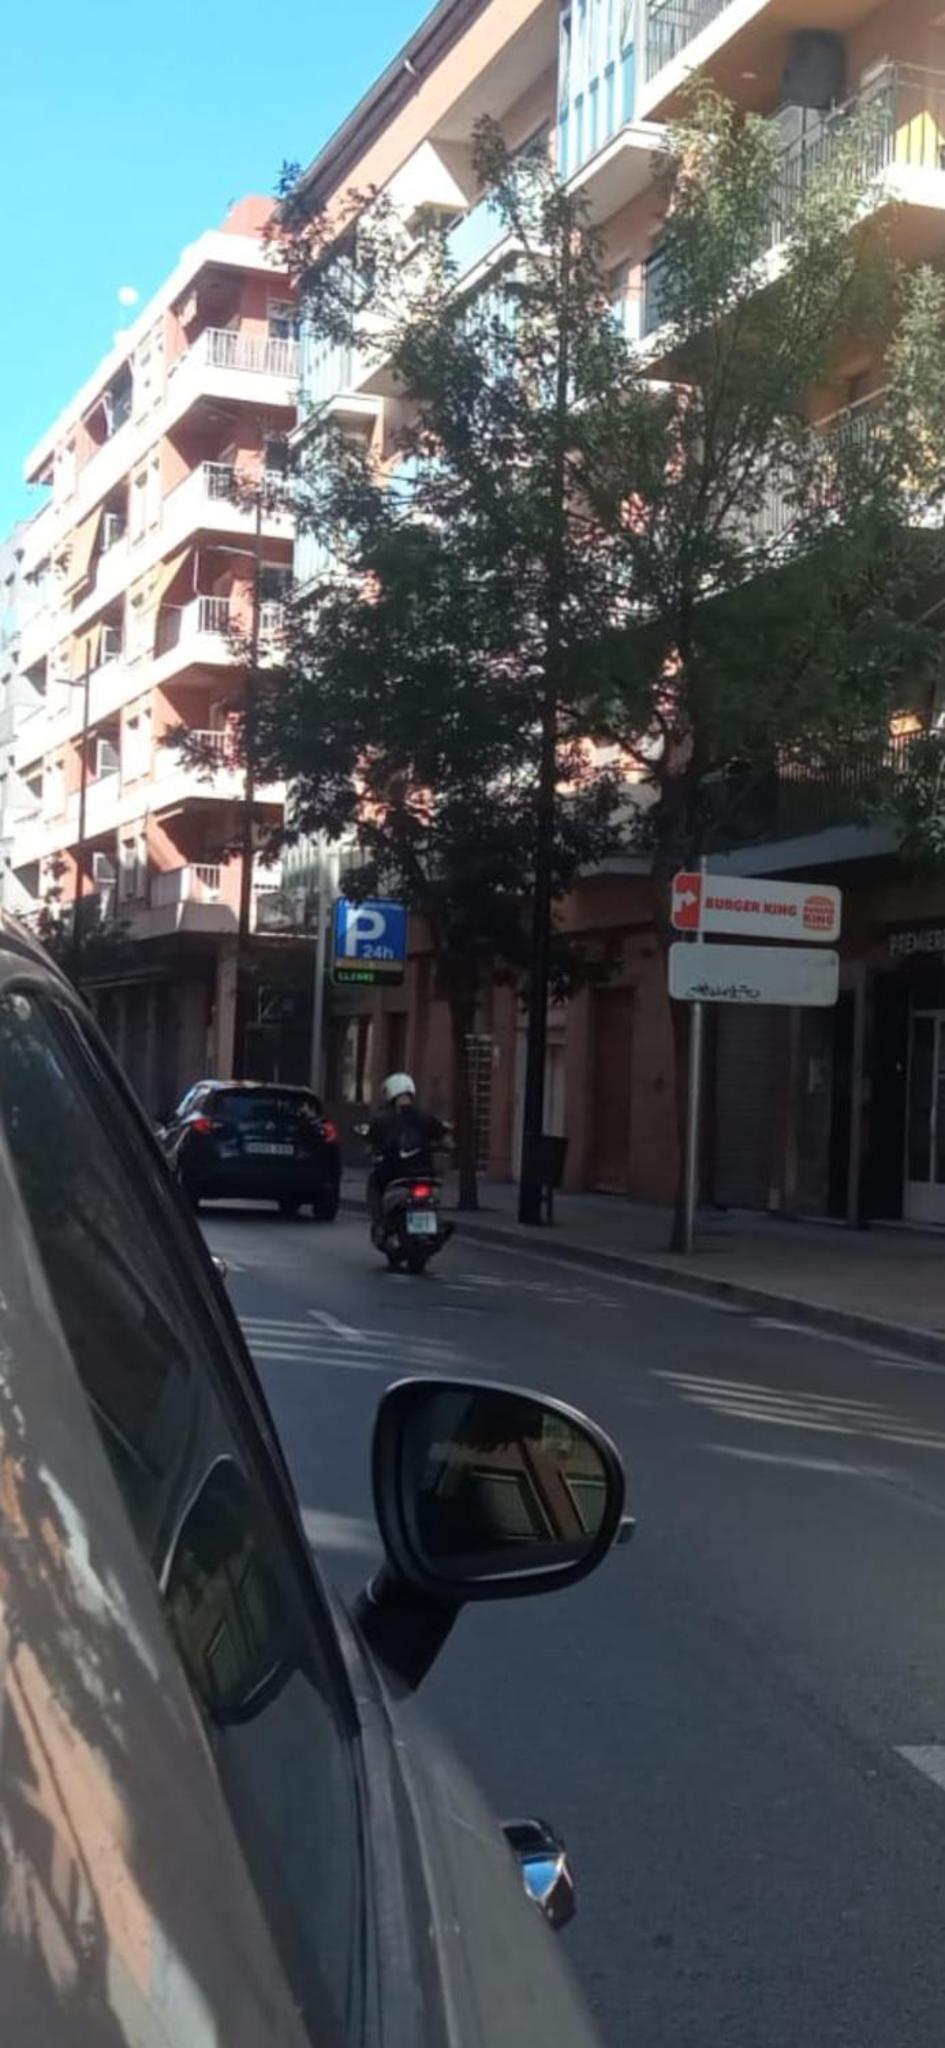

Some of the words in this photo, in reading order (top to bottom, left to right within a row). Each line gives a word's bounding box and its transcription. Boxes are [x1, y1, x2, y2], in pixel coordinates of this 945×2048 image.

[706, 896, 760, 913] BURGER
[763, 901, 798, 917] KING
[346, 907, 386, 957] P
[362, 944, 395, 960] 24h
